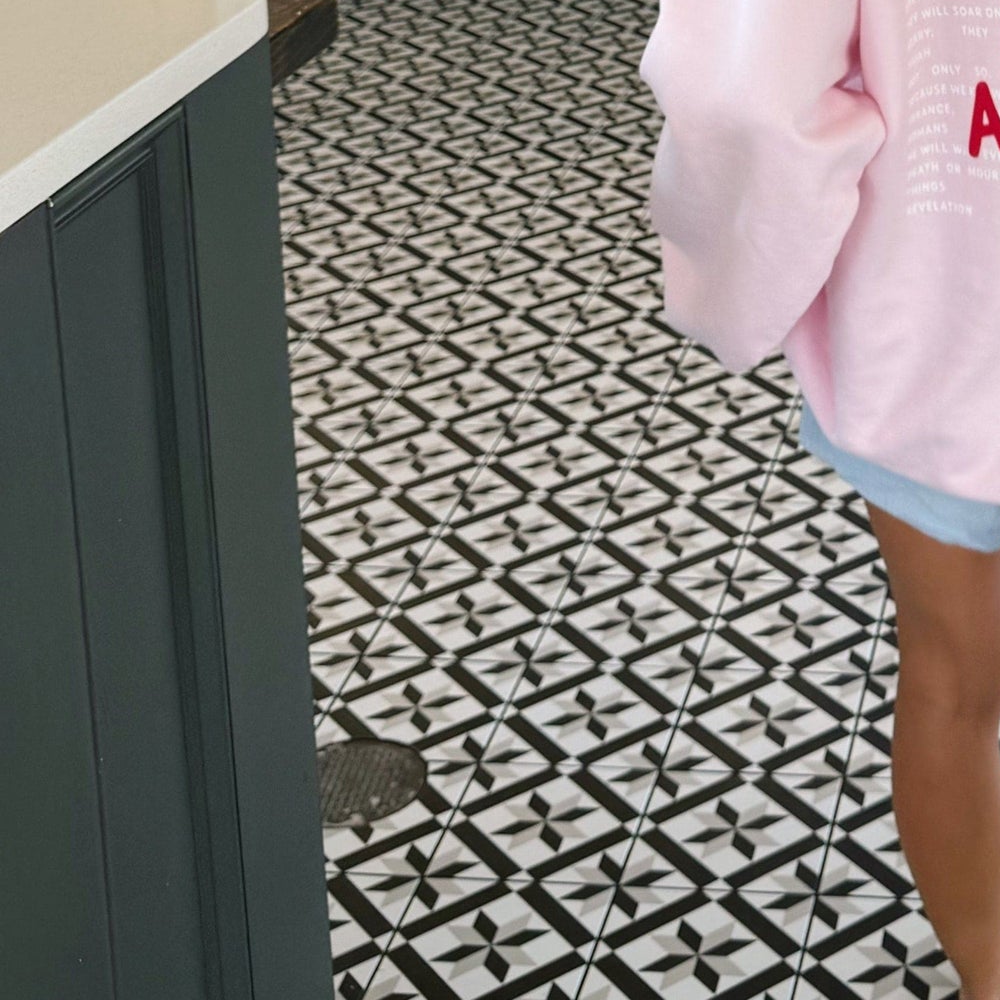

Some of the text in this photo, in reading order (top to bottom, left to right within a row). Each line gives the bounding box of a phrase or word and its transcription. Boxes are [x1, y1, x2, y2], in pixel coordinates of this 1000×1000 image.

[920, 4, 949, 20] WILL
[951, 4, 983, 19] SOAR
[961, 24, 989, 39] THEY
[931, 63, 962, 77] ONLY
